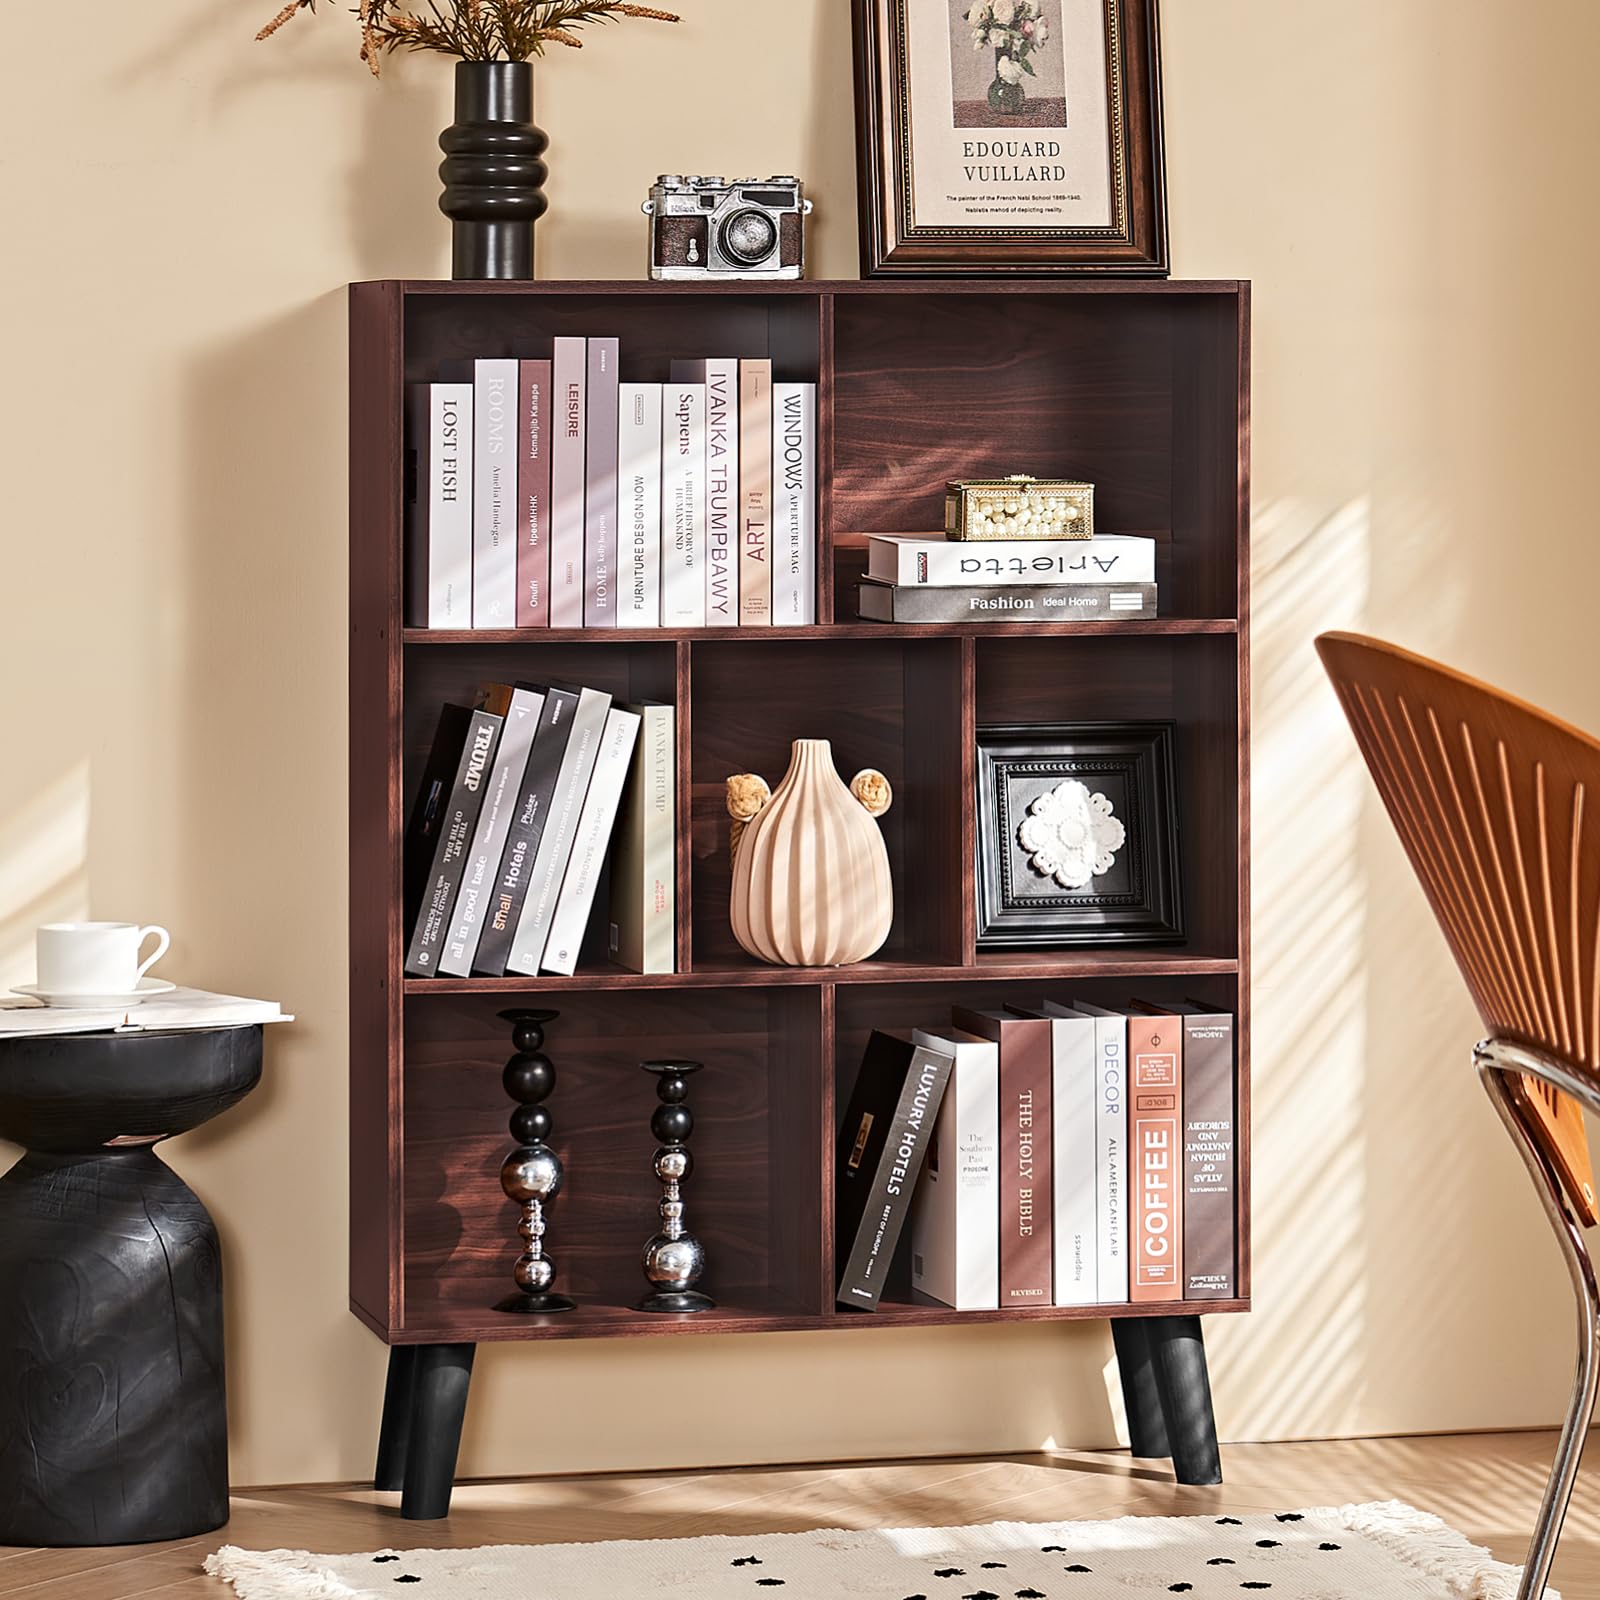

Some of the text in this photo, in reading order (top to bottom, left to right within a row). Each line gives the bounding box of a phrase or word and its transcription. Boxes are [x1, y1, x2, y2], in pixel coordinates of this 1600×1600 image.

[963, 142, 1061, 157] EDOUARD
[964, 166, 1066, 181] VUILLARD
[488, 378, 504, 454] ROOMS
[568, 383, 579, 438] LEISURE
[675, 394, 693, 455] Sapiens
[442, 400, 458, 502] LOST FISH
[784, 394, 802, 490] WINDOWS
[491, 465, 501, 547] Amelia Handegan
[685, 480, 694, 509] BRIEF
[711, 374, 728, 614] IVANKA TRUMPBAWY
[675, 488, 684, 550] HUMANKIND
[685, 510, 694, 552] HISTORY
[747, 518, 765, 562] ART
[790, 494, 800, 574] APERTURE MAG
[597, 543, 607, 562] kelly
[634, 475, 644, 610] FURNITURE DESIGN NOW
[685, 554, 694, 568] OF
[596, 565, 607, 608] HOME
[960, 556, 1119, 574] Arletta
[969, 597, 1097, 609] Fashion Ideal Home
[464, 725, 494, 792] TRUMP
[610, 722, 625, 758] LEAN IN
[655, 716, 664, 811] IVANKA TRUMP
[520, 792, 536, 824] Phuket
[442, 810, 462, 863] OF THE DEAL
[452, 820, 468, 856] THE ART
[574, 807, 604, 896] SHERYL SANDBERG
[437, 881, 450, 910] DONALD
[449, 854, 487, 958] all in good taste
[492, 839, 527, 930] small Hotels
[421, 874, 445, 945] with TONY SCHWARTZ
[429, 916, 441, 941] TRUMP
[1104, 1044, 1120, 1114] DECOR
[888, 1063, 938, 1196] LUXURY HOTELS
[1186, 1142, 1231, 1151] ANATOMY
[1187, 1121, 1230, 1130] SURGERY
[1198, 1132, 1218, 1140] AND
[960, 1144, 992, 1152] Southern
[1019, 1090, 1033, 1237] THE HOLY BIBLE
[1190, 1152, 1226, 1161] HUMAN
[1201, 1163, 1216, 1172] OF
[1108, 1138, 1118, 1256] ALL-AMERICAN FLAIR
[1145, 1131, 1168, 1257] COFFEE
[1194, 1174, 1223, 1182] ATLAS
[878, 1221, 886, 1230] OF
[881, 1204, 891, 1221] BEST
[871, 1229, 883, 1255] EUROPE
[1074, 1234, 1082, 1281] happiness
[1010, 1288, 1043, 1297] REVISED
